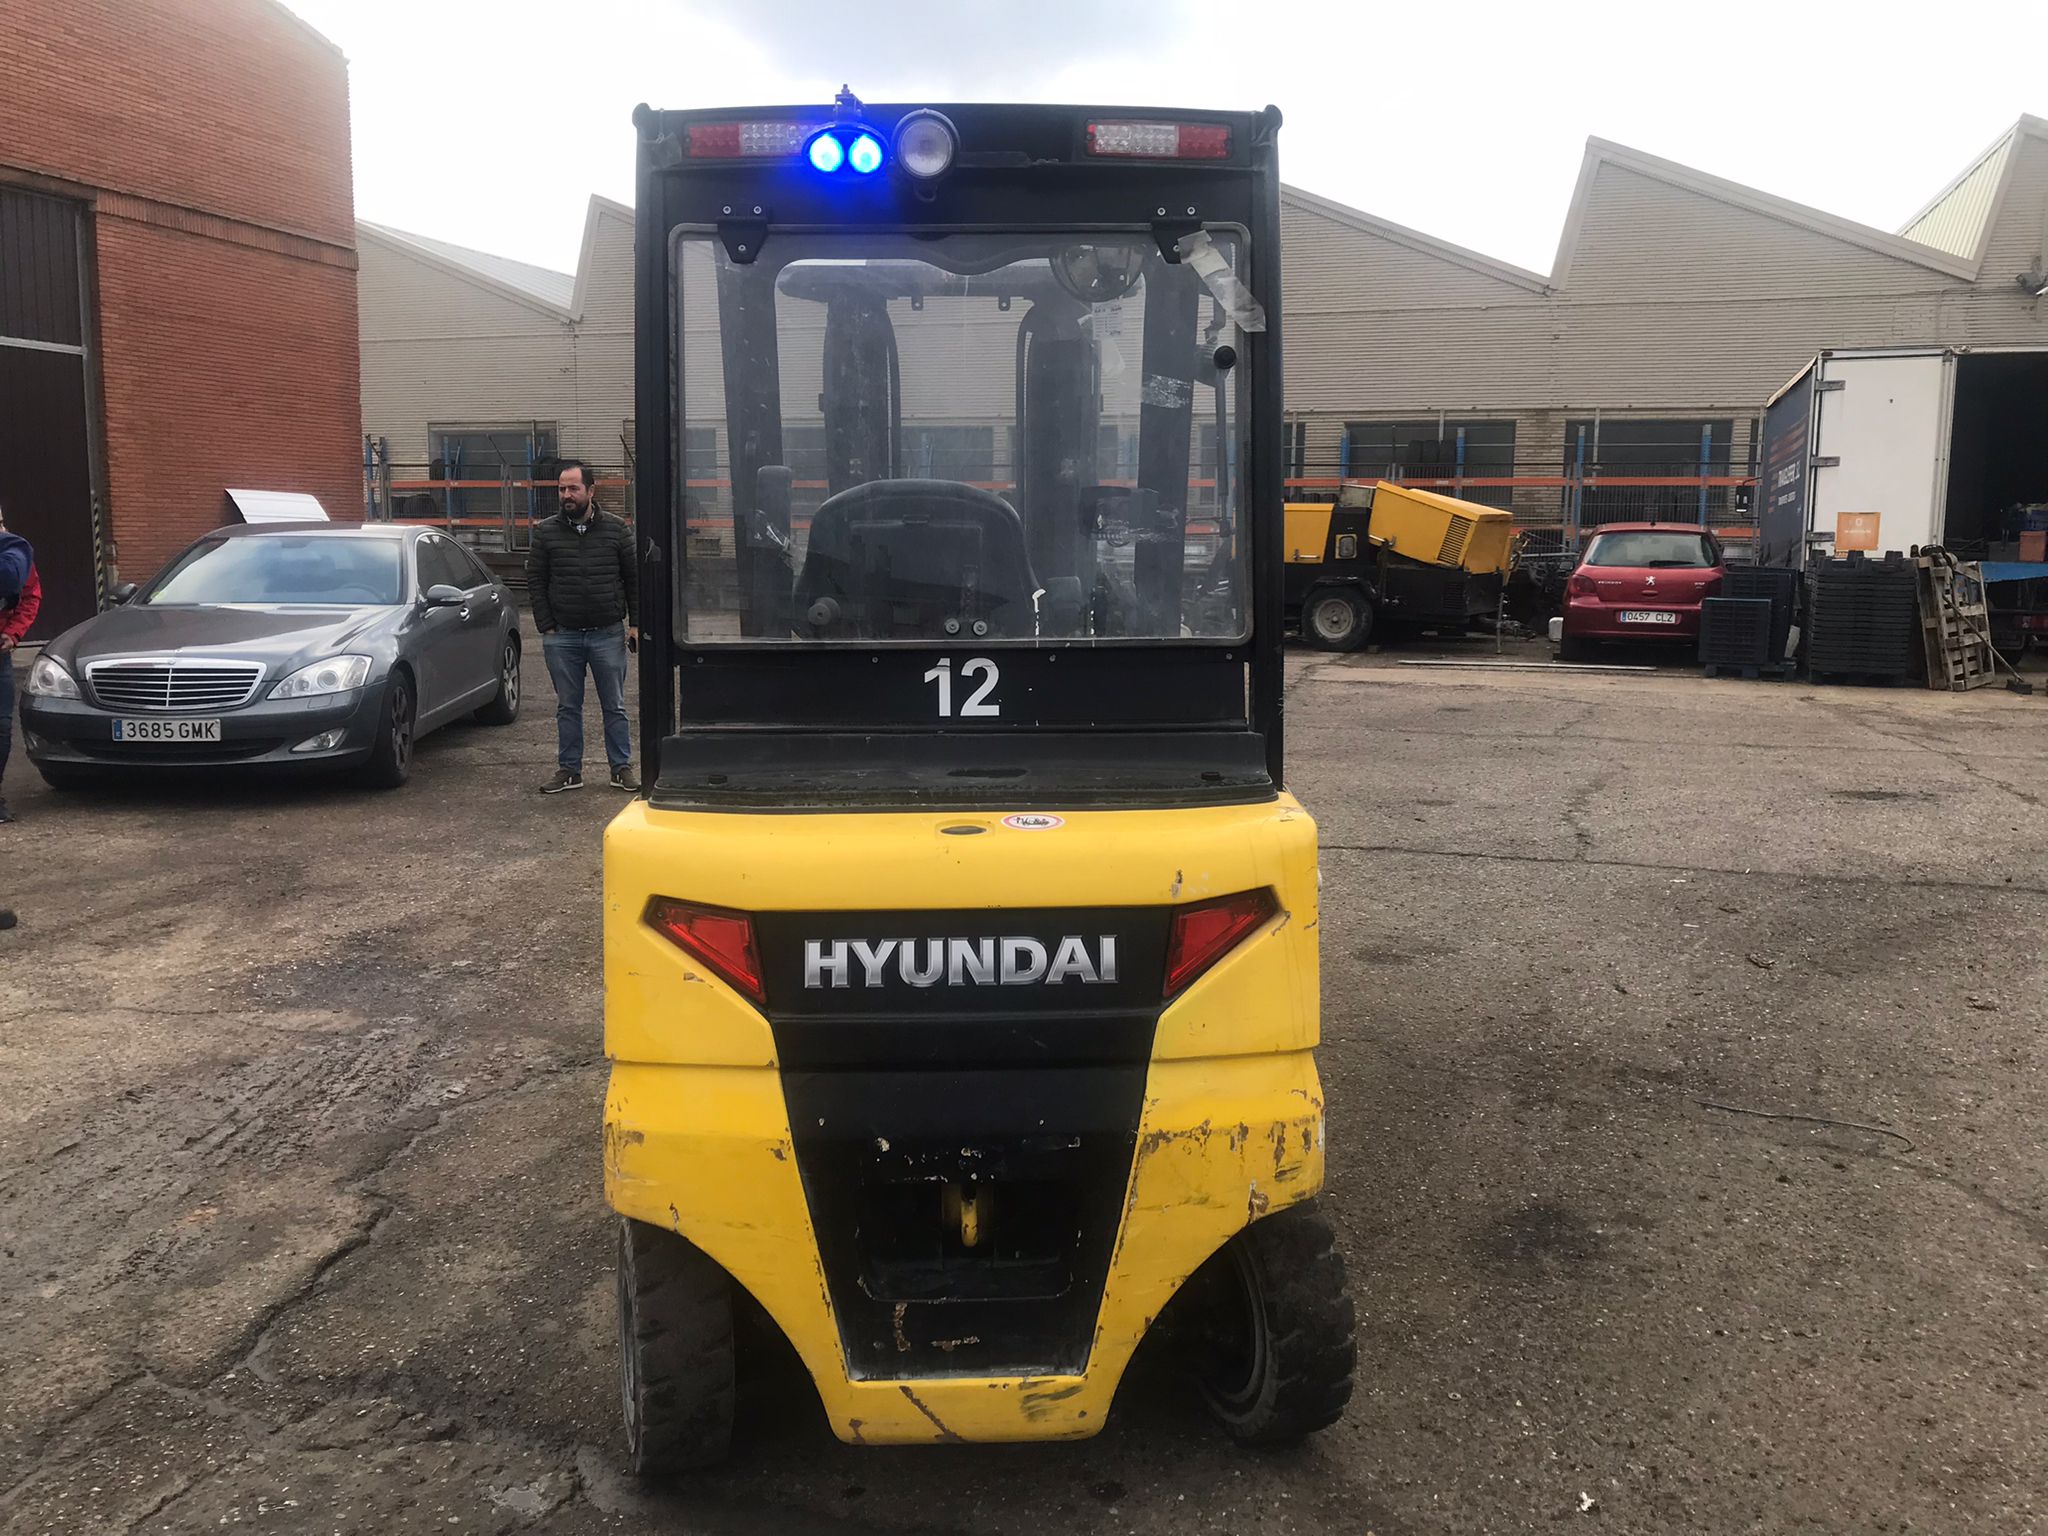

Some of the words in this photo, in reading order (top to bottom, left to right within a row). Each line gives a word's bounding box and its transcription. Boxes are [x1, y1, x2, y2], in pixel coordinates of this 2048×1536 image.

[1627, 612, 1650, 621] 0457
[1655, 613, 1673, 622] CLZ
[924, 658, 1000, 717] 12
[126, 722, 174, 739] 3685
[178, 722, 215, 739] GMK
[804, 934, 1119, 989] HYUNDAI
